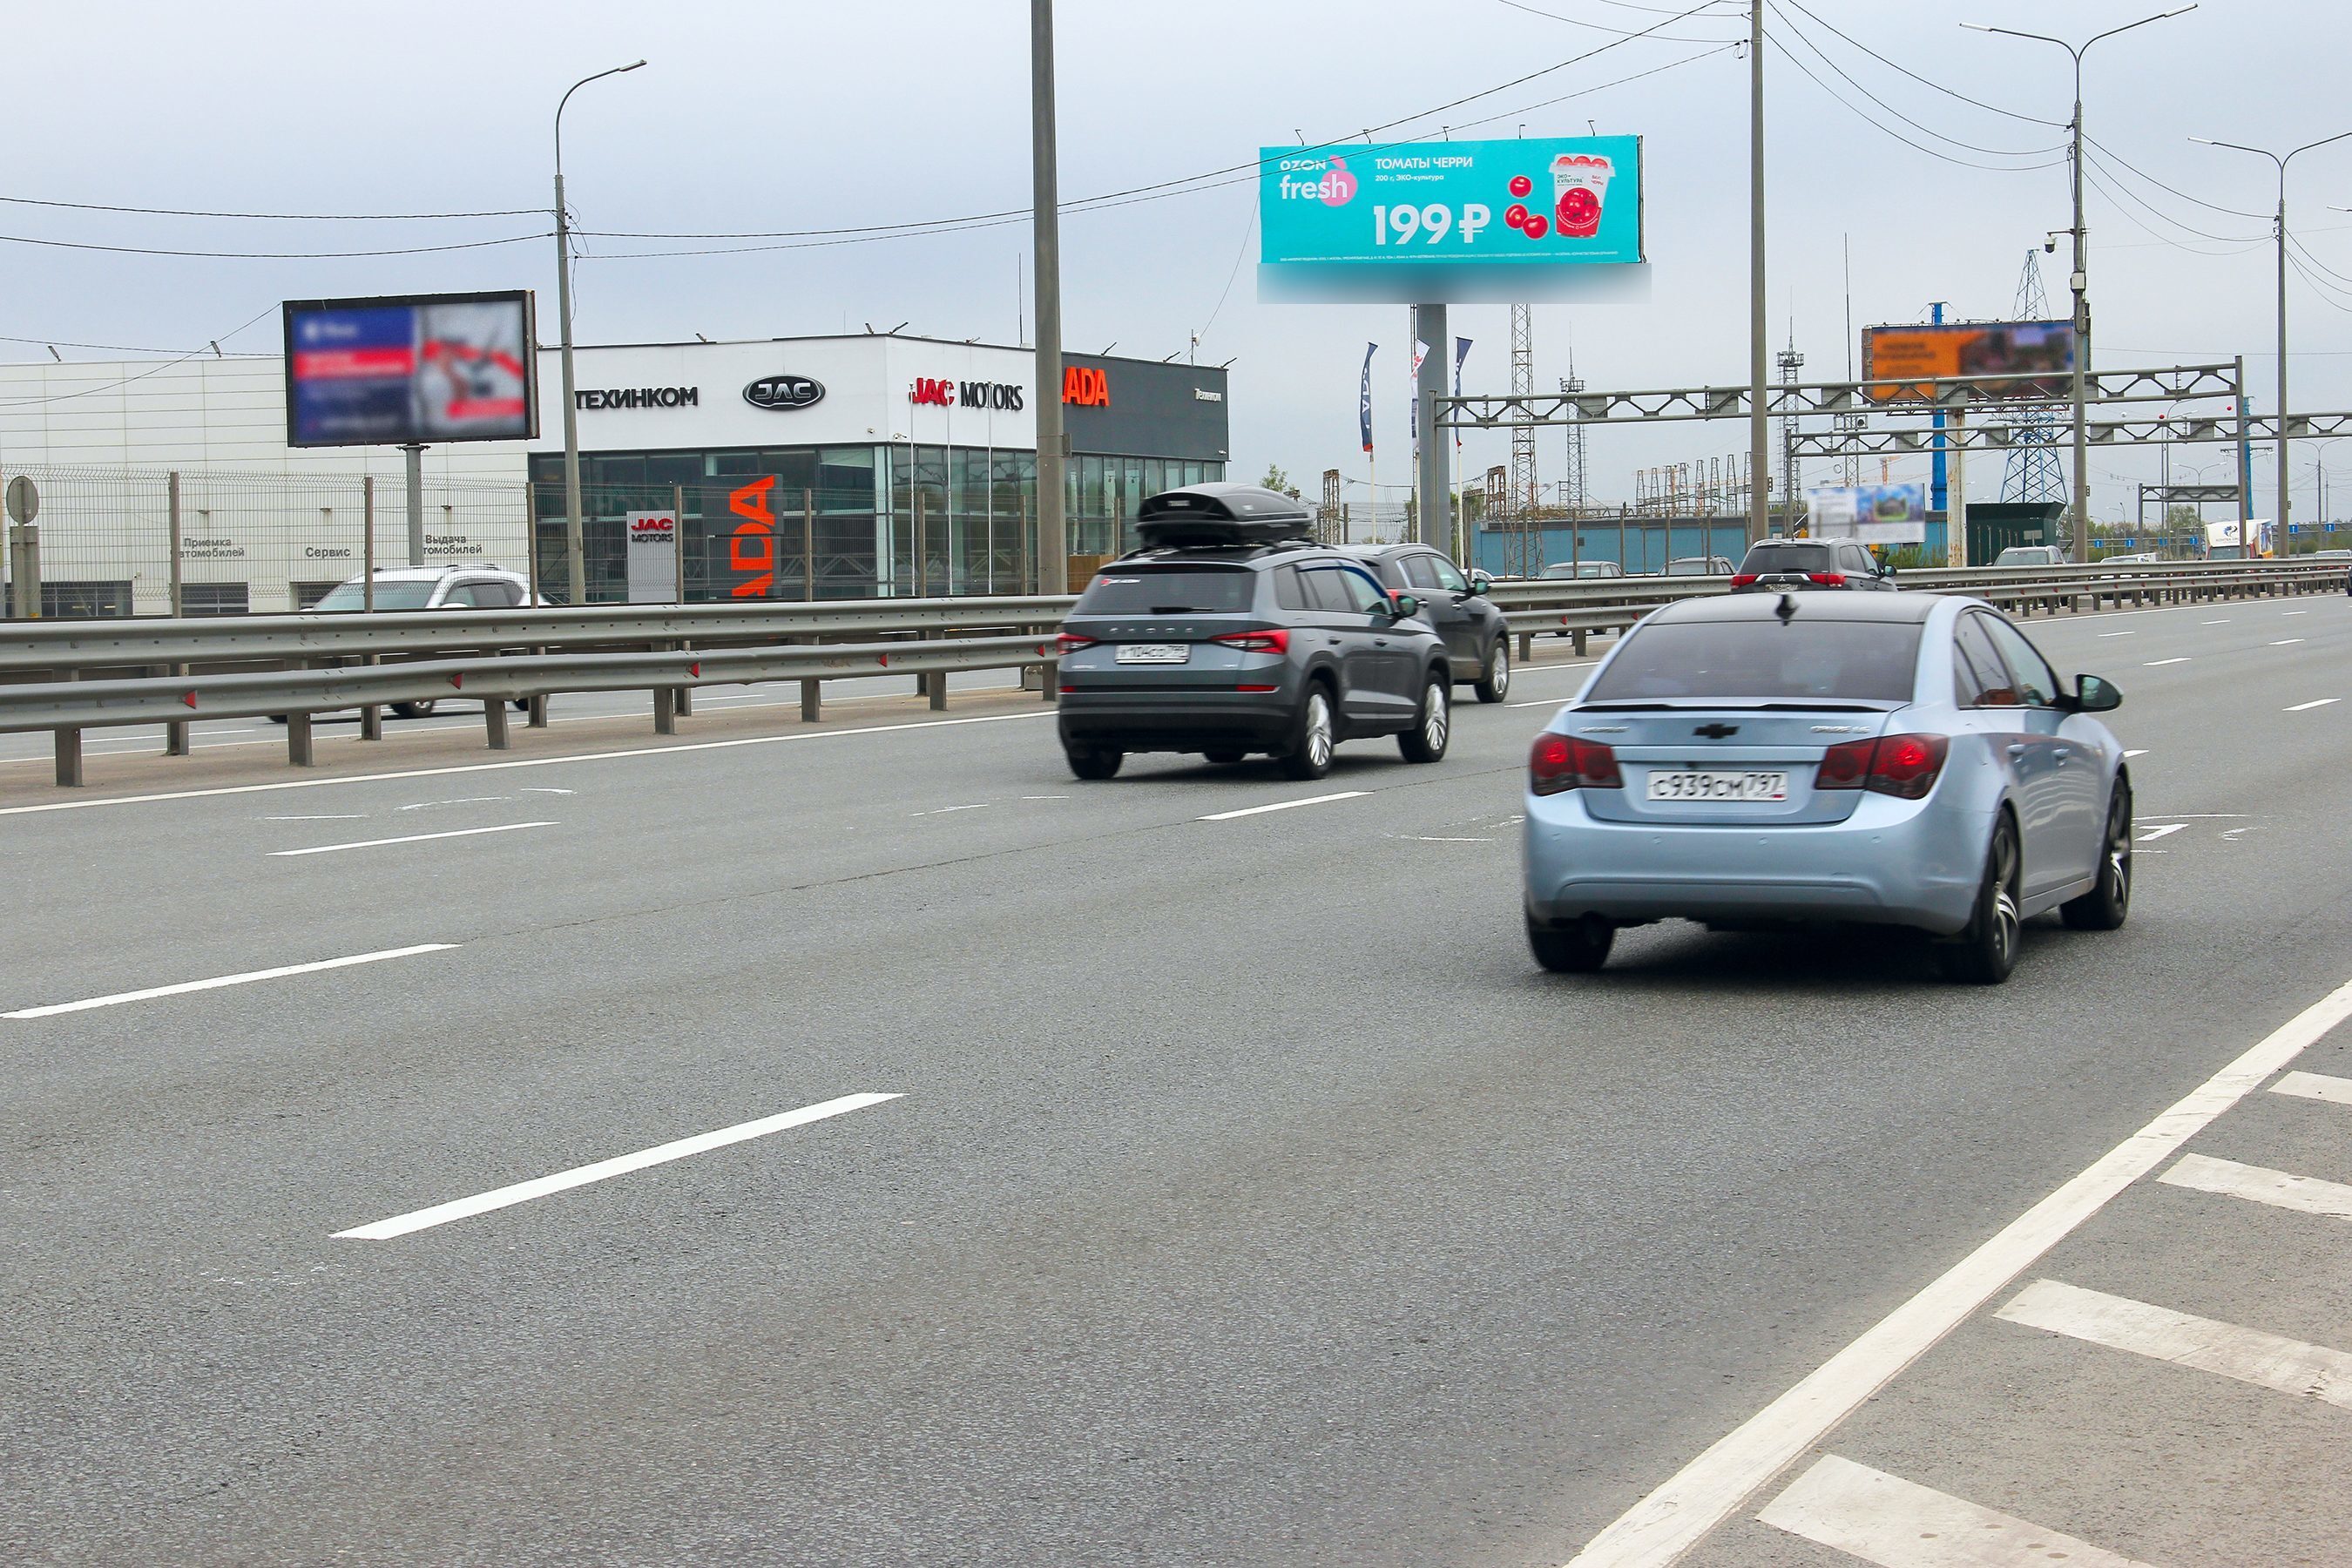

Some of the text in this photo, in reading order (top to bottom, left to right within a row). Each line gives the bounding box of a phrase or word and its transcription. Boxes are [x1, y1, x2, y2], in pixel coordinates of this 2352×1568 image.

[1280, 159, 1327, 172] OZON
[1375, 157, 1473, 170] ТОМАТЫ ЧЕРРИ
[1279, 174, 1348, 199] fresh
[1373, 204, 1452, 246] 199
[754, 382, 812, 400] JAC
[1062, 366, 1111, 407] ADA
[574, 386, 698, 409] ТЕХИНКОМ
[909, 377, 1024, 411] JAC MOTORS
[631, 517, 673, 531] JAC
[184, 537, 232, 549] Приемка
[425, 534, 467, 545] Выдача
[631, 533, 674, 544] MOTORS
[179, 547, 245, 558] втомобилей
[305, 546, 351, 559] Сервис
[422, 544, 483, 555] томобилей
